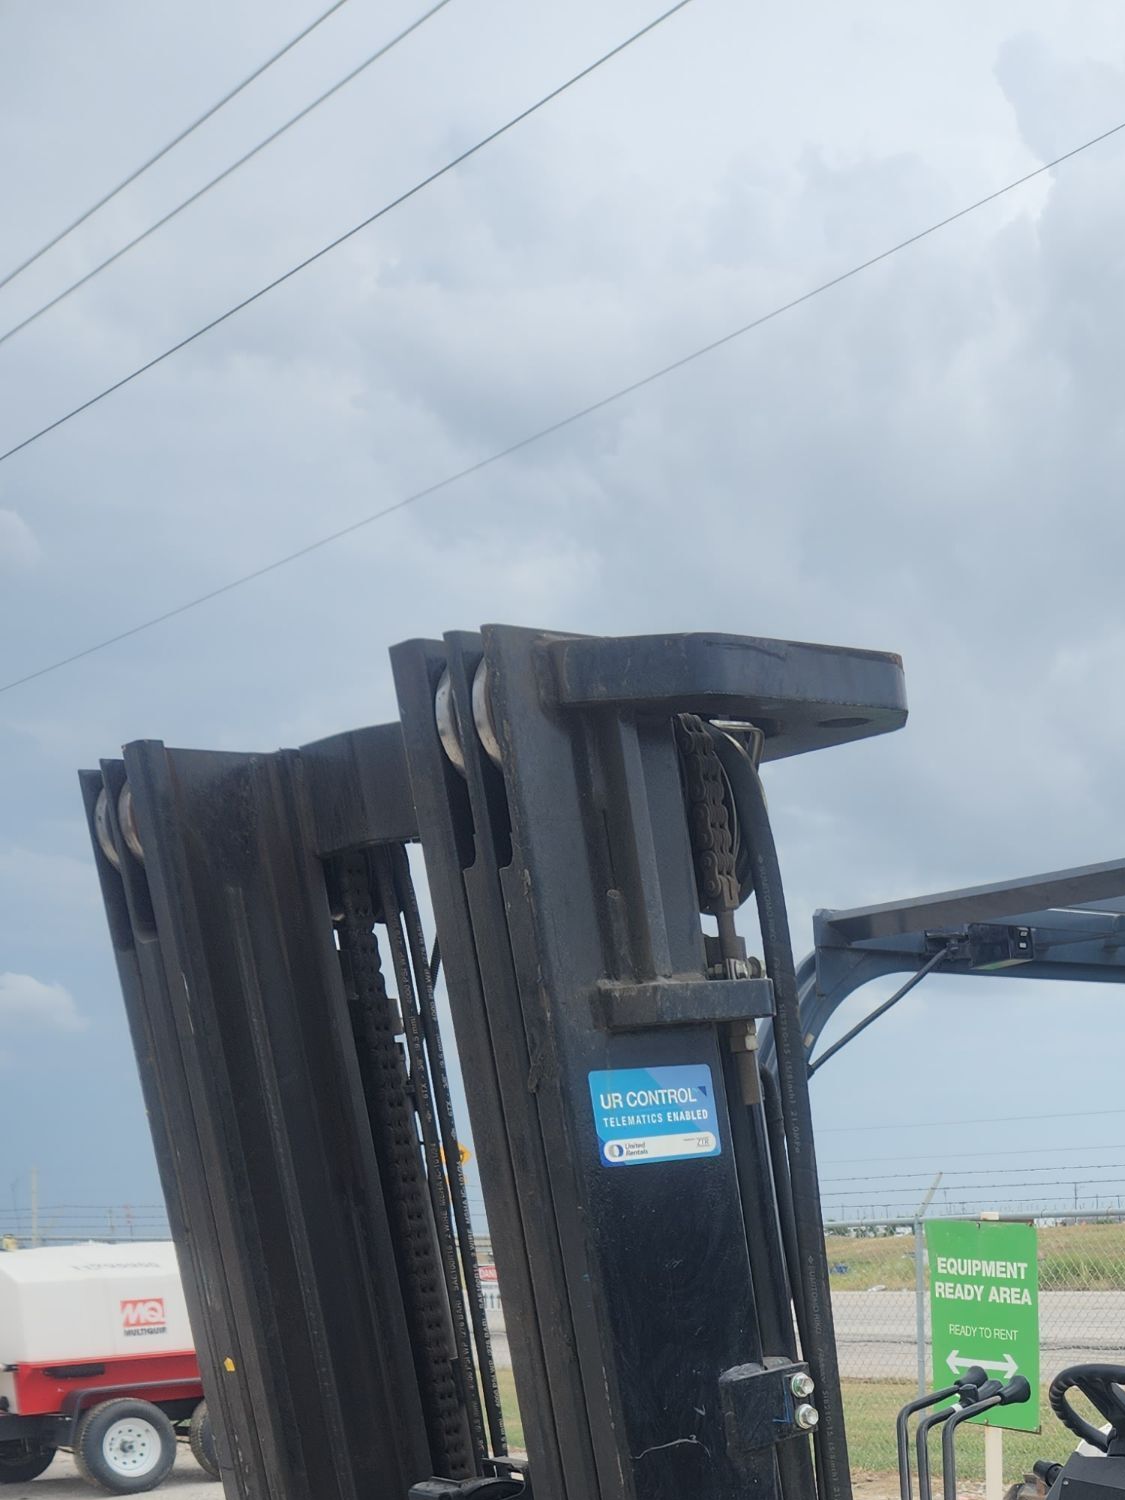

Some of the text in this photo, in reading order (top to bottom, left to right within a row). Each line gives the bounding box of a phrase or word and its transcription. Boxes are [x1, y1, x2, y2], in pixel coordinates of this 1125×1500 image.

[600, 1087, 697, 1110] UR CONTROL
[604, 1108, 708, 1128] TELEMATICS ENABLED
[625, 1142, 646, 1150] United
[625, 1147, 649, 1157] Rentals
[937, 1256, 1028, 1280] EQUIPMENT
[934, 1281, 1033, 1306] READY AREA
[121, 1300, 162, 1325] MQ
[948, 1323, 1019, 1341] READY TO RENT
